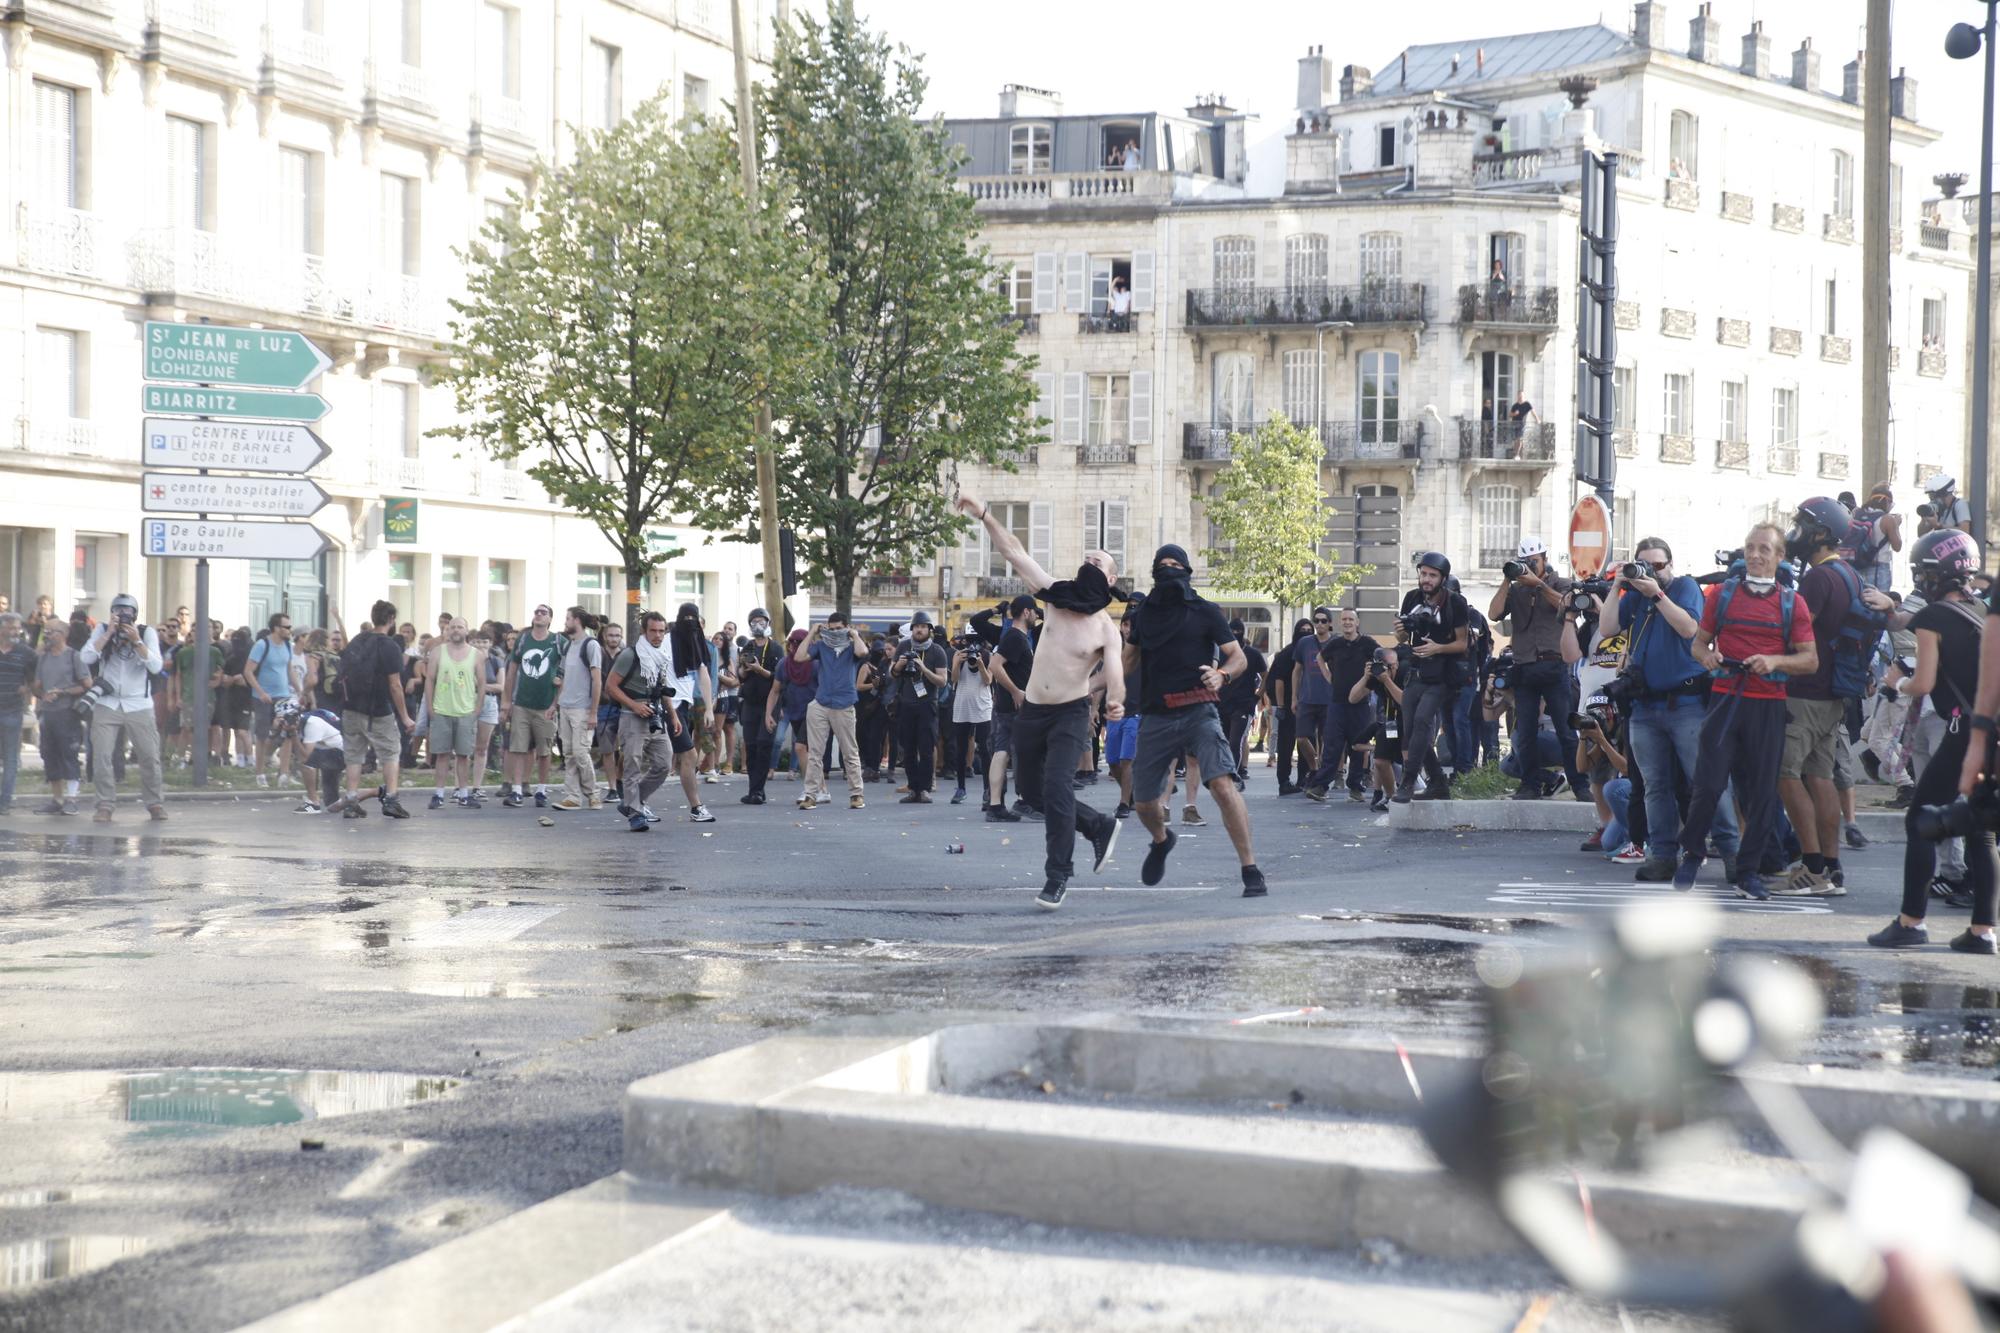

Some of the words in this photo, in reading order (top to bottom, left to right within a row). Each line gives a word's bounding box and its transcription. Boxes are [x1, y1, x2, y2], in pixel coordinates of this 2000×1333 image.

[179, 330, 226, 348] JEAN
[235, 338, 251, 350] DE
[260, 335, 292, 352] LUZ
[151, 346, 240, 364] DONIBANE
[151, 361, 237, 379] LOHIZUNE
[151, 391, 237, 410] BIARRITZ
[192, 426, 249, 440] CENTRE
[257, 429, 295, 442] VILLE
[191, 440, 225, 450] HIRI
[232, 442, 292, 454] BARNEA
[191, 452, 216, 463] COR
[222, 454, 237, 464] DE
[243, 454, 268, 465] VILA
[171, 484, 218, 494] centre
[225, 483, 304, 498] hospitalier
[171, 525, 189, 536] De
[198, 525, 246, 538] Gaulle
[172, 539, 224, 552] Vauban
